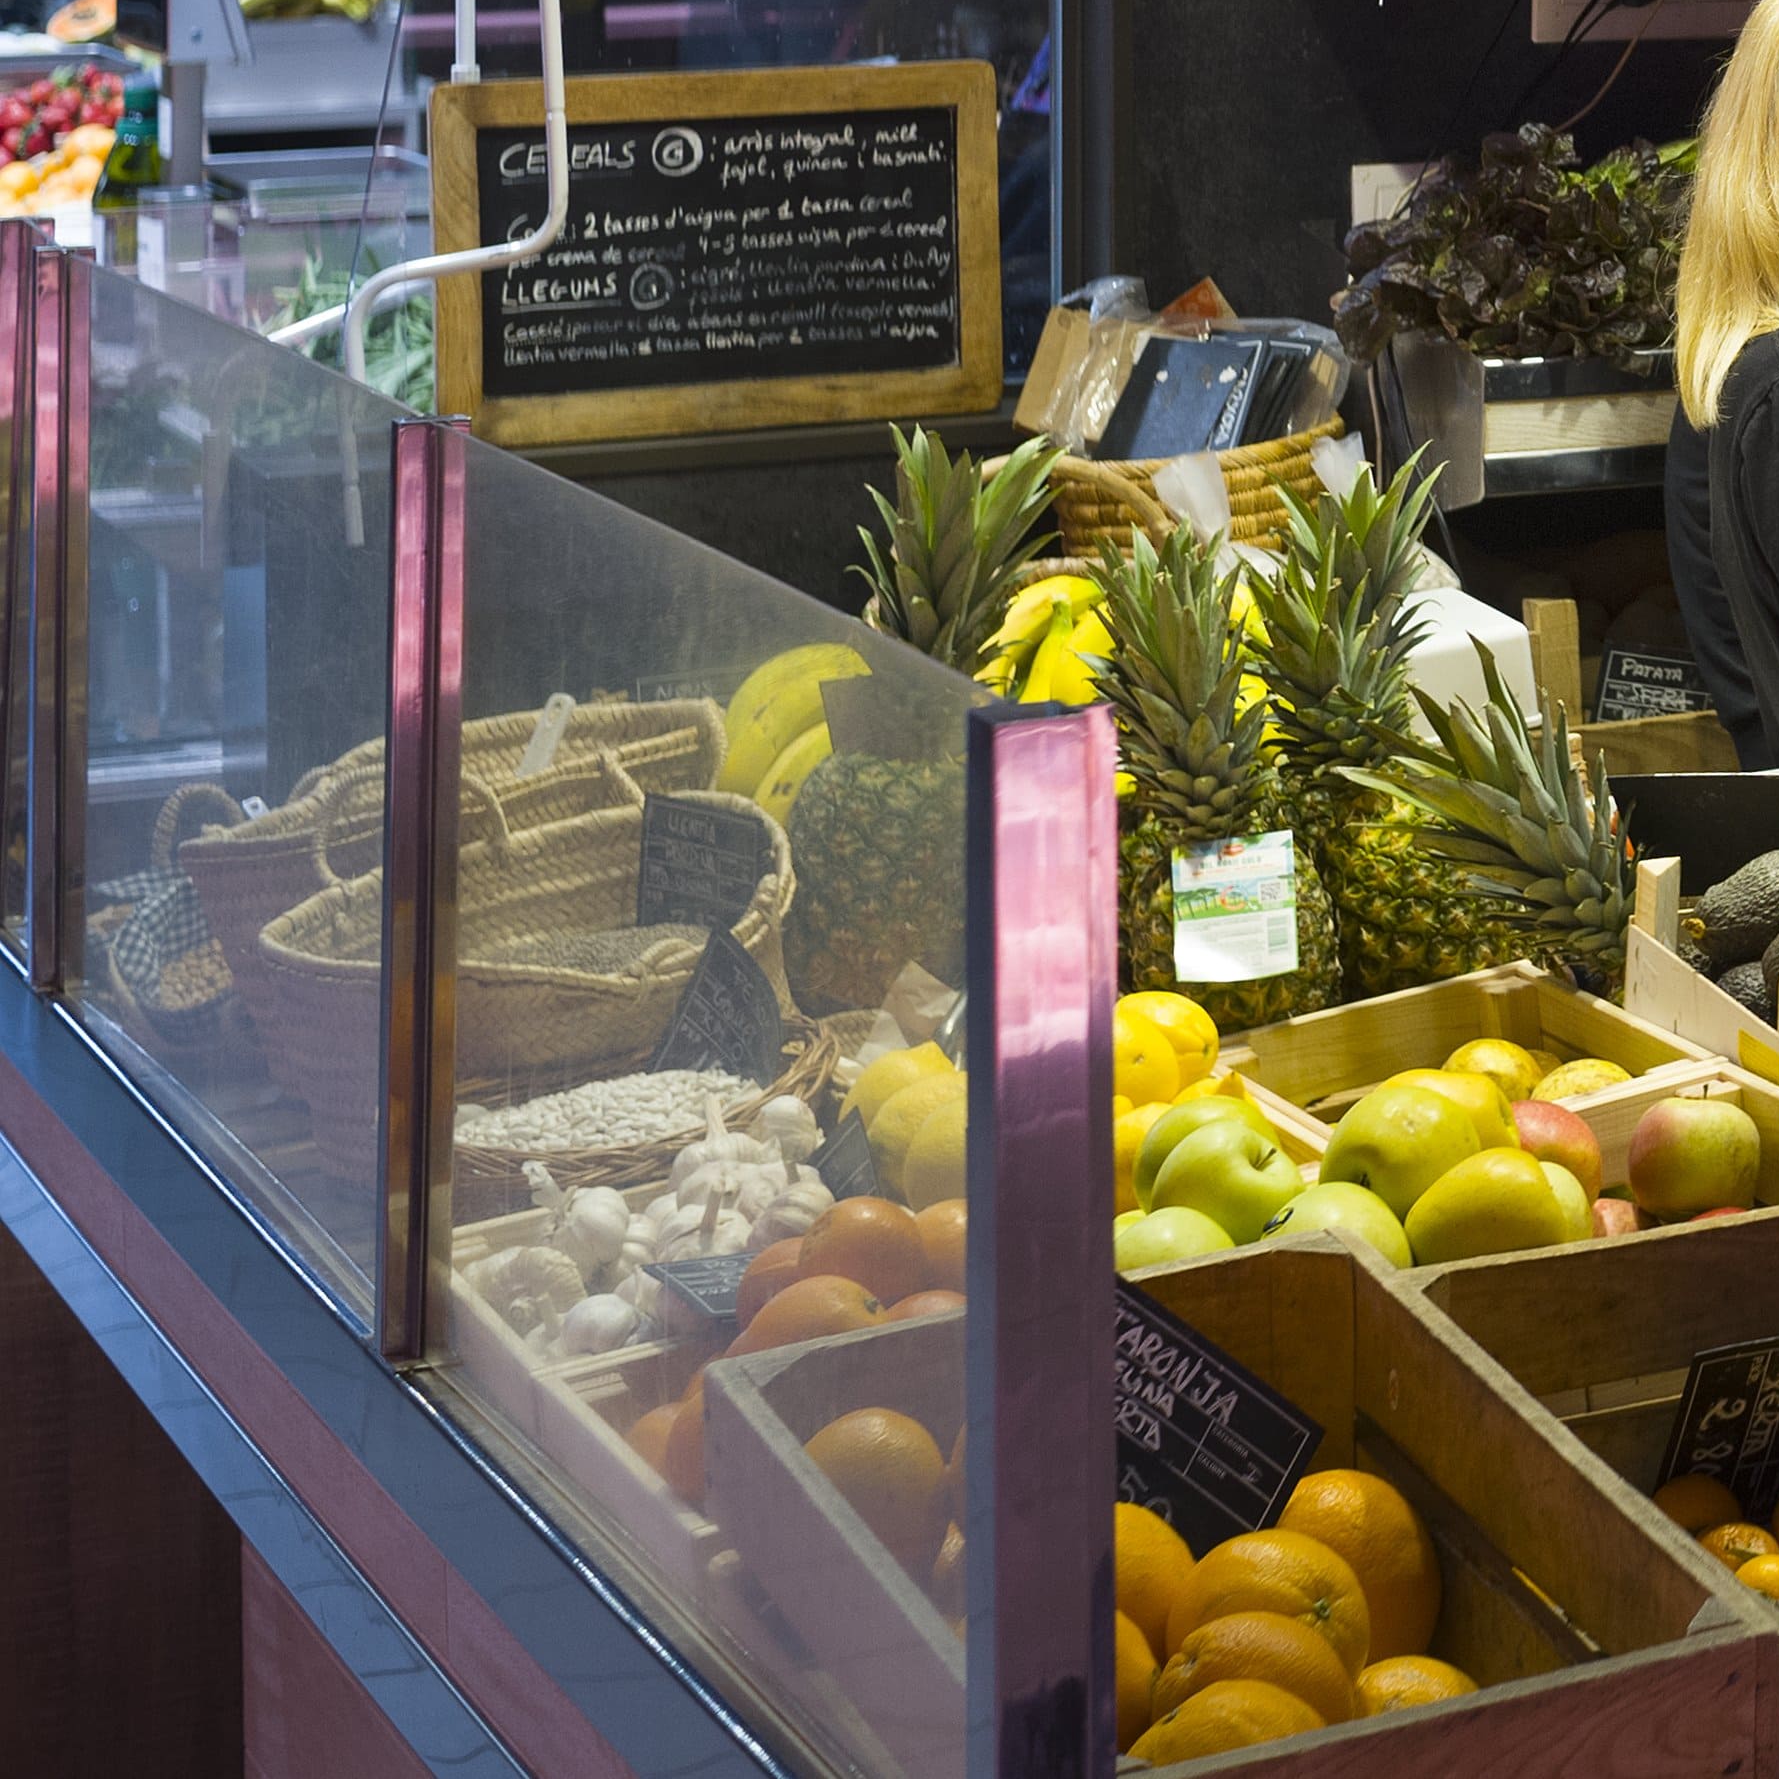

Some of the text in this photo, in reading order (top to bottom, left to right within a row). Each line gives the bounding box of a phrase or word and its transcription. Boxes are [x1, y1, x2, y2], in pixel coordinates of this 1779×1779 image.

[500, 139, 636, 178] CEEALS
[604, 212, 659, 237] tasses
[860, 186, 912, 212] cereal
[502, 272, 617, 307] LLEGUMS
